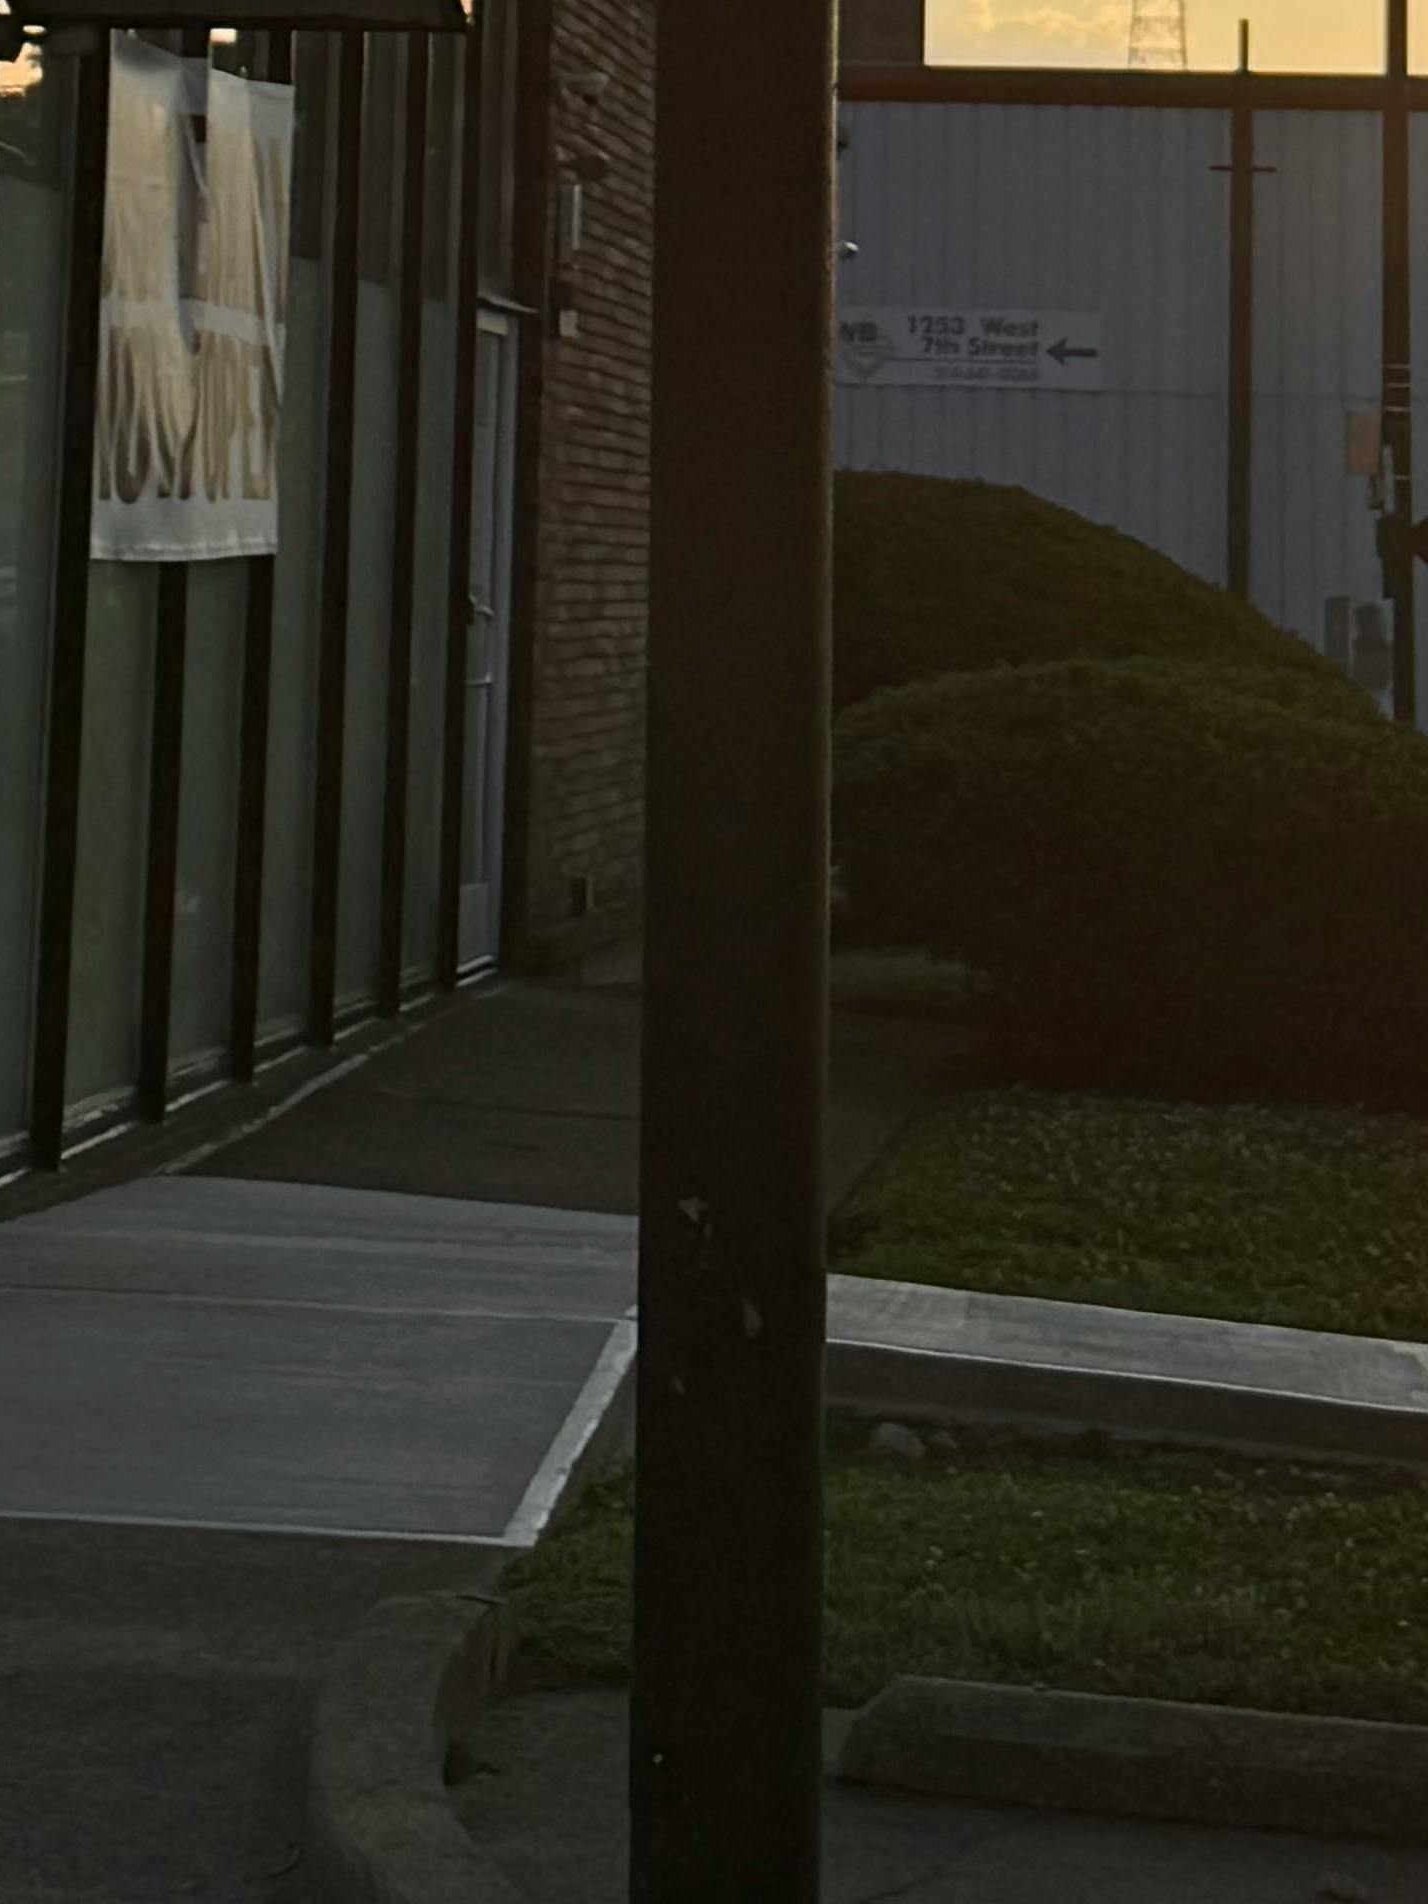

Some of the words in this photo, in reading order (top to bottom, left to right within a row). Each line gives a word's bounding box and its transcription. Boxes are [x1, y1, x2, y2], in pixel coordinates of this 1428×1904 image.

[978, 316, 1039, 336] West
[921, 336, 960, 354] 7th
[968, 337, 1039, 357] Street
